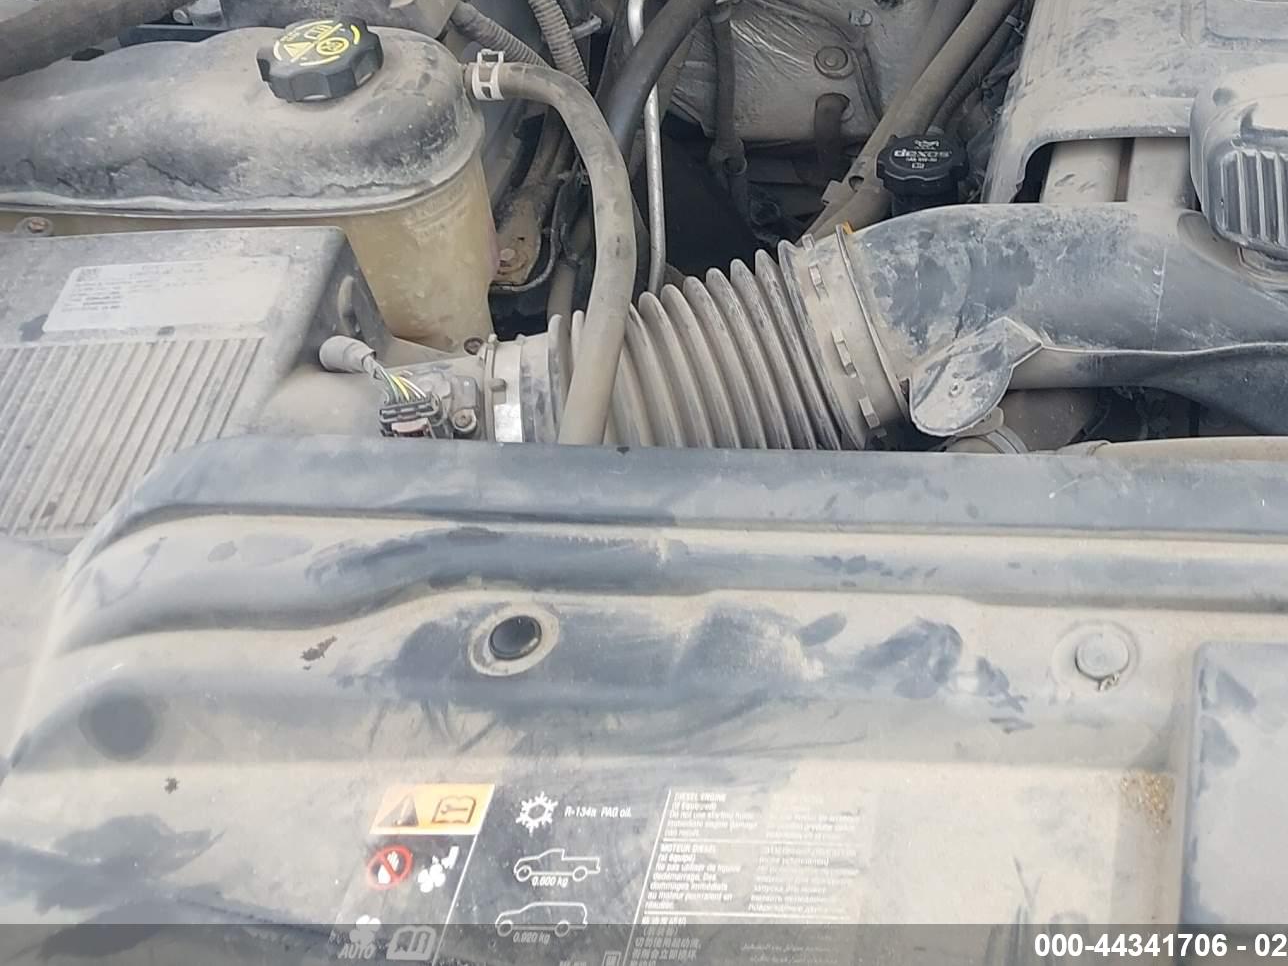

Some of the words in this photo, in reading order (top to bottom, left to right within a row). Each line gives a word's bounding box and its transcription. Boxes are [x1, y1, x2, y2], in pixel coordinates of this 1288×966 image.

[894, 148, 950, 158] dexos
[557, 875, 569, 888] kg
[338, 943, 377, 959] AUTO
